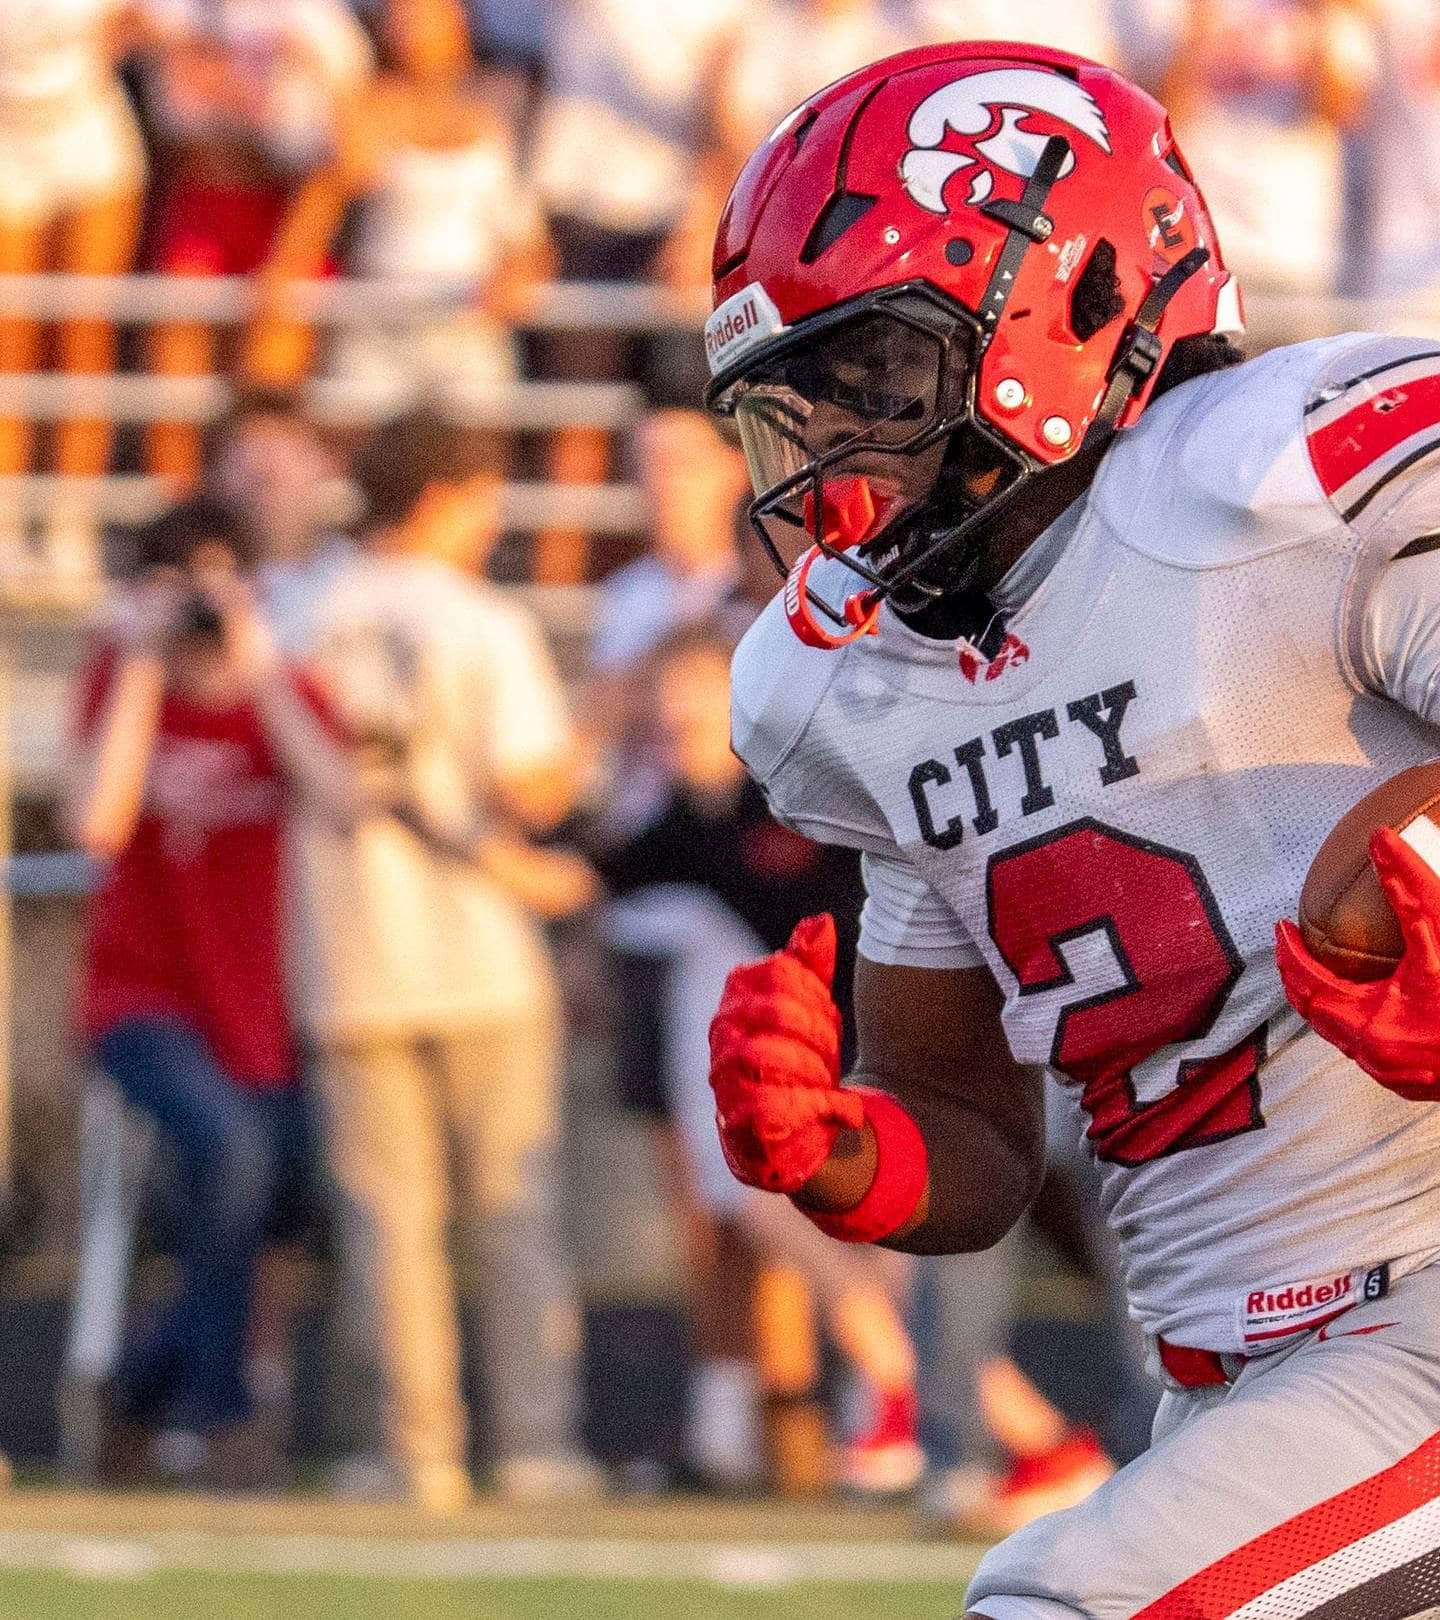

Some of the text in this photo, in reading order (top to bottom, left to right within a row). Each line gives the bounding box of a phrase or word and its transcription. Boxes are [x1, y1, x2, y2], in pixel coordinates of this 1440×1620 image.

[1151, 202, 1185, 250] E
[907, 679, 1141, 851] CITY
[985, 815, 1267, 1169] 2
[1246, 1274, 1351, 1314] Riddell
[1246, 1314, 1286, 1326] PROTECT
